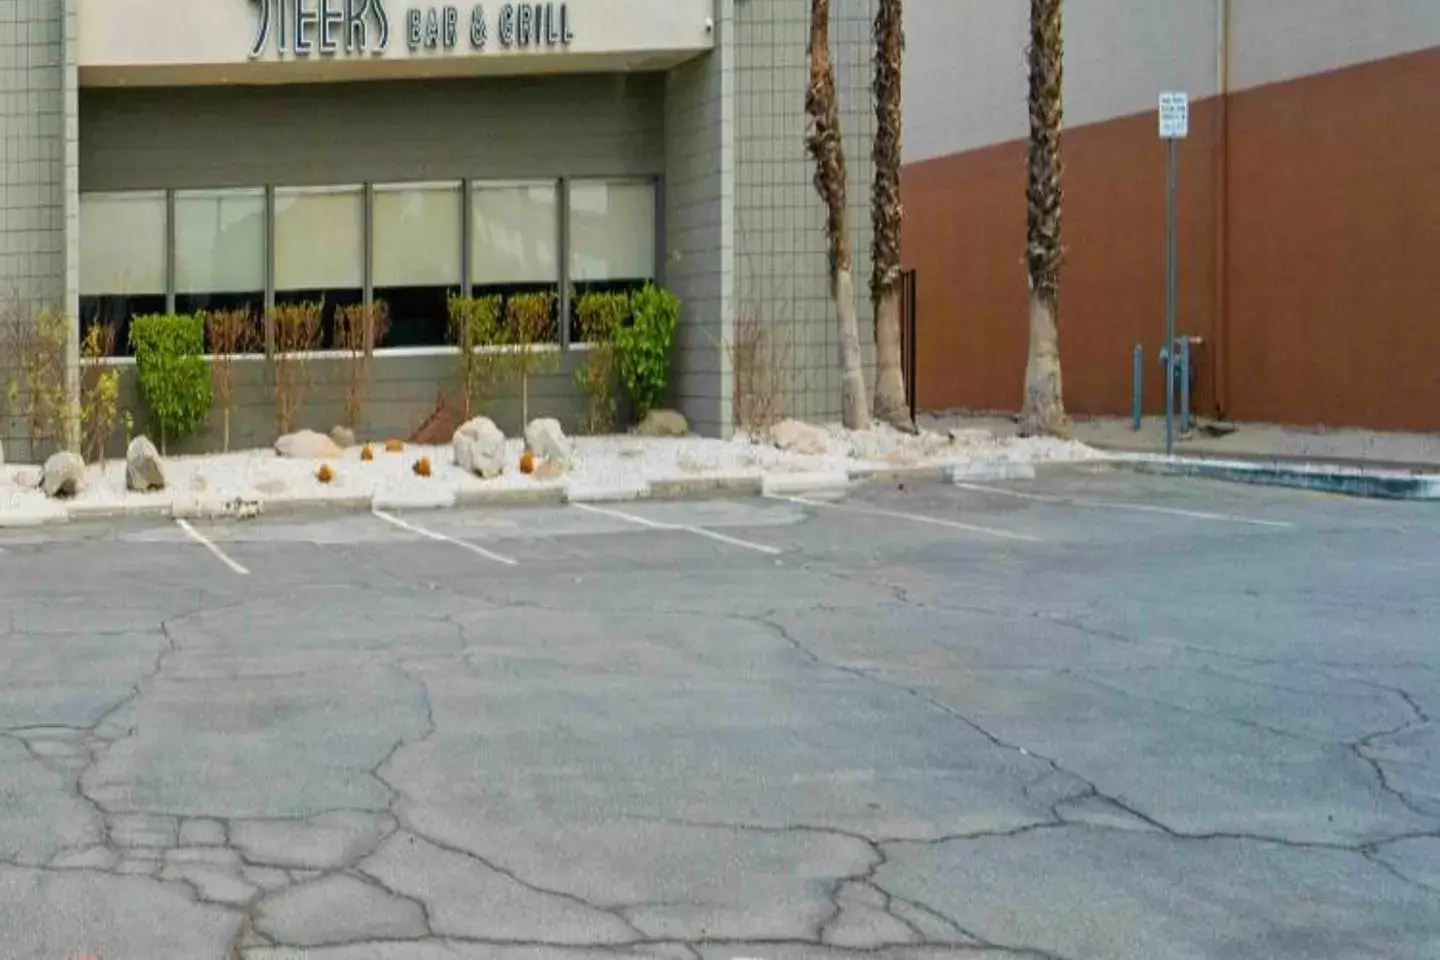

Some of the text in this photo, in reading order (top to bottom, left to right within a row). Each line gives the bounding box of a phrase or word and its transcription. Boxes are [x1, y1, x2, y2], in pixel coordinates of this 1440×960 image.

[407, 6, 458, 50] BAR
[469, 4, 488, 47] &
[498, 2, 574, 46] GRILL
